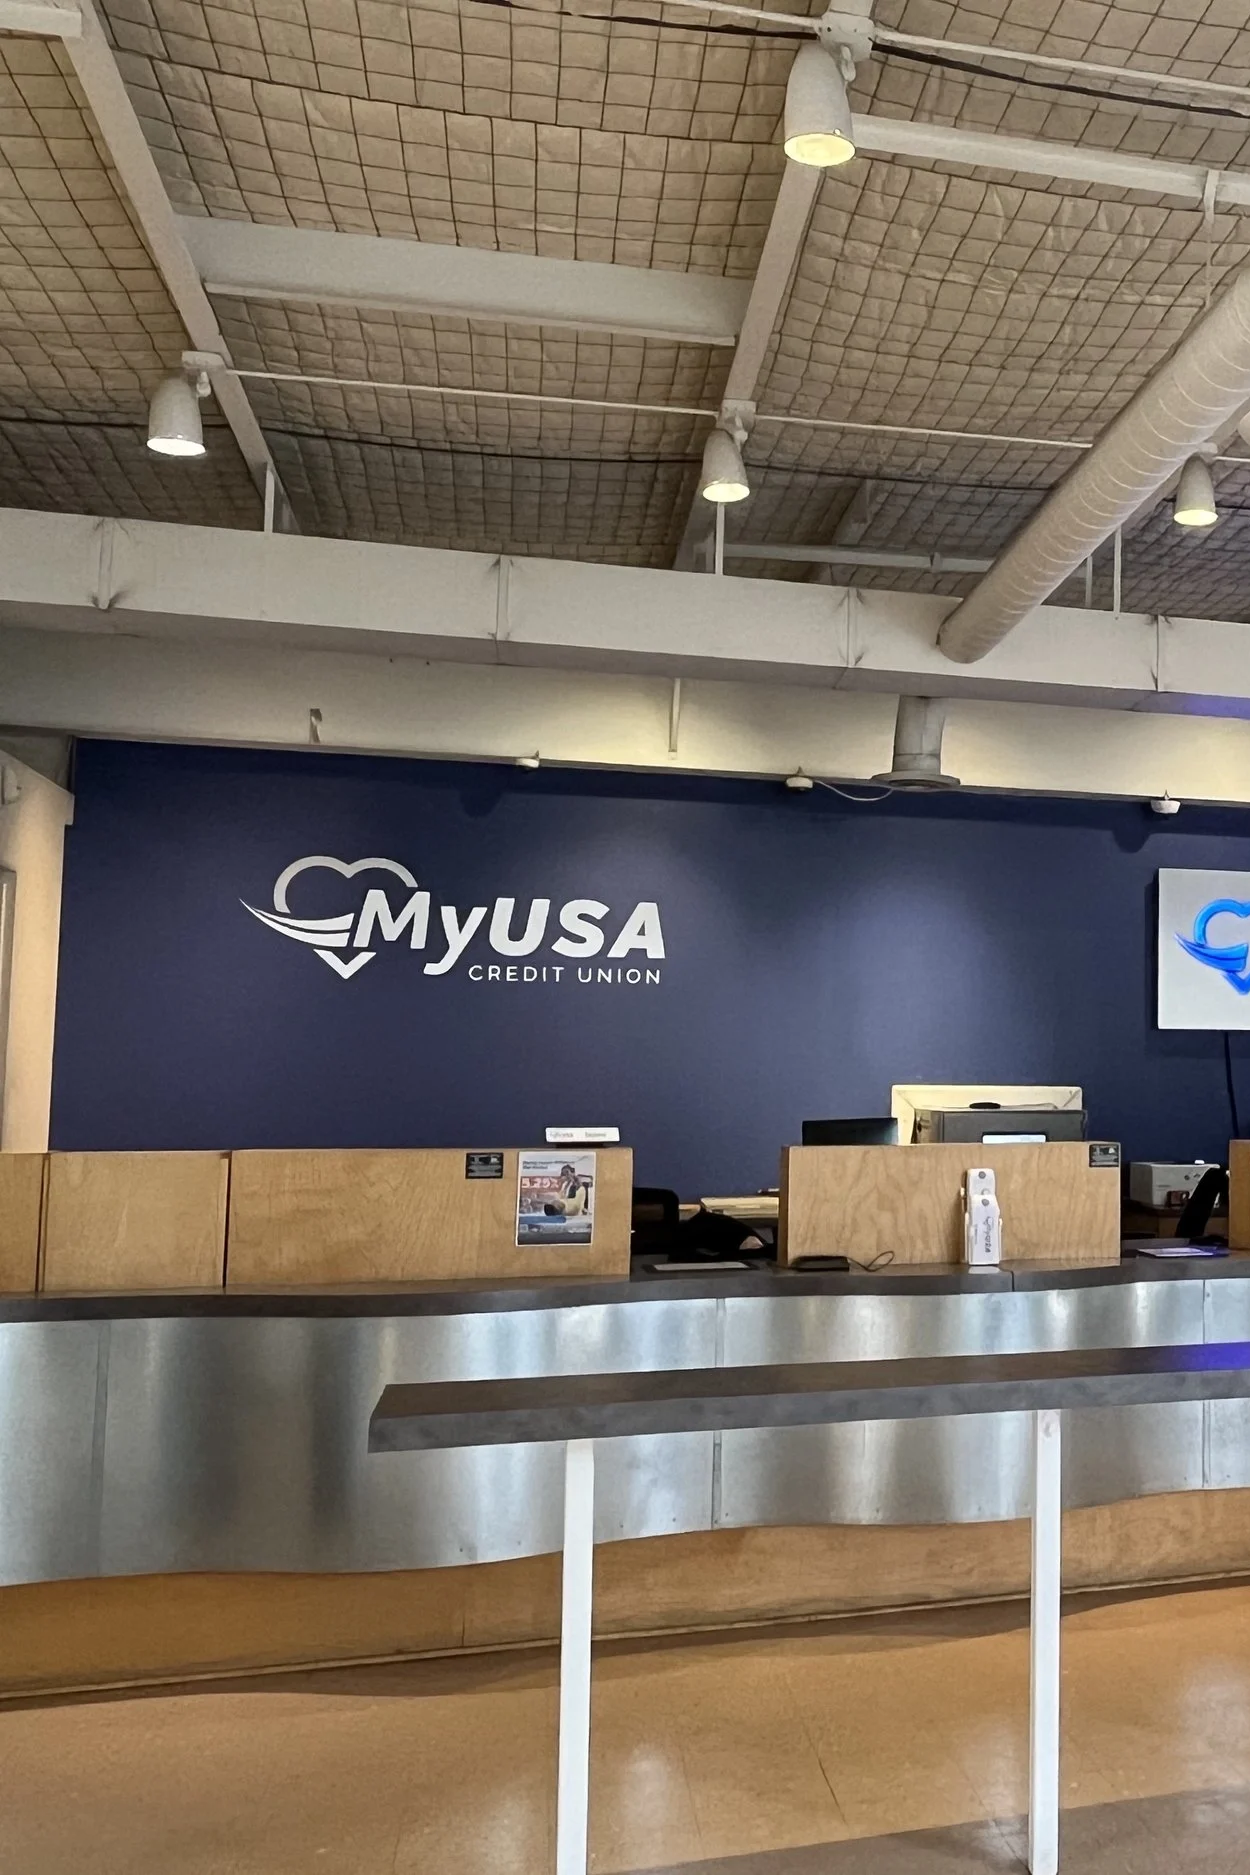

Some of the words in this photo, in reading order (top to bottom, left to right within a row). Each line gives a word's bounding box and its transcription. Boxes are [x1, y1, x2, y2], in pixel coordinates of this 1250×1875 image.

[352, 889, 666, 976] MyUSA
[468, 964, 565, 983] CREDIT
[577, 967, 660, 985] UNION
